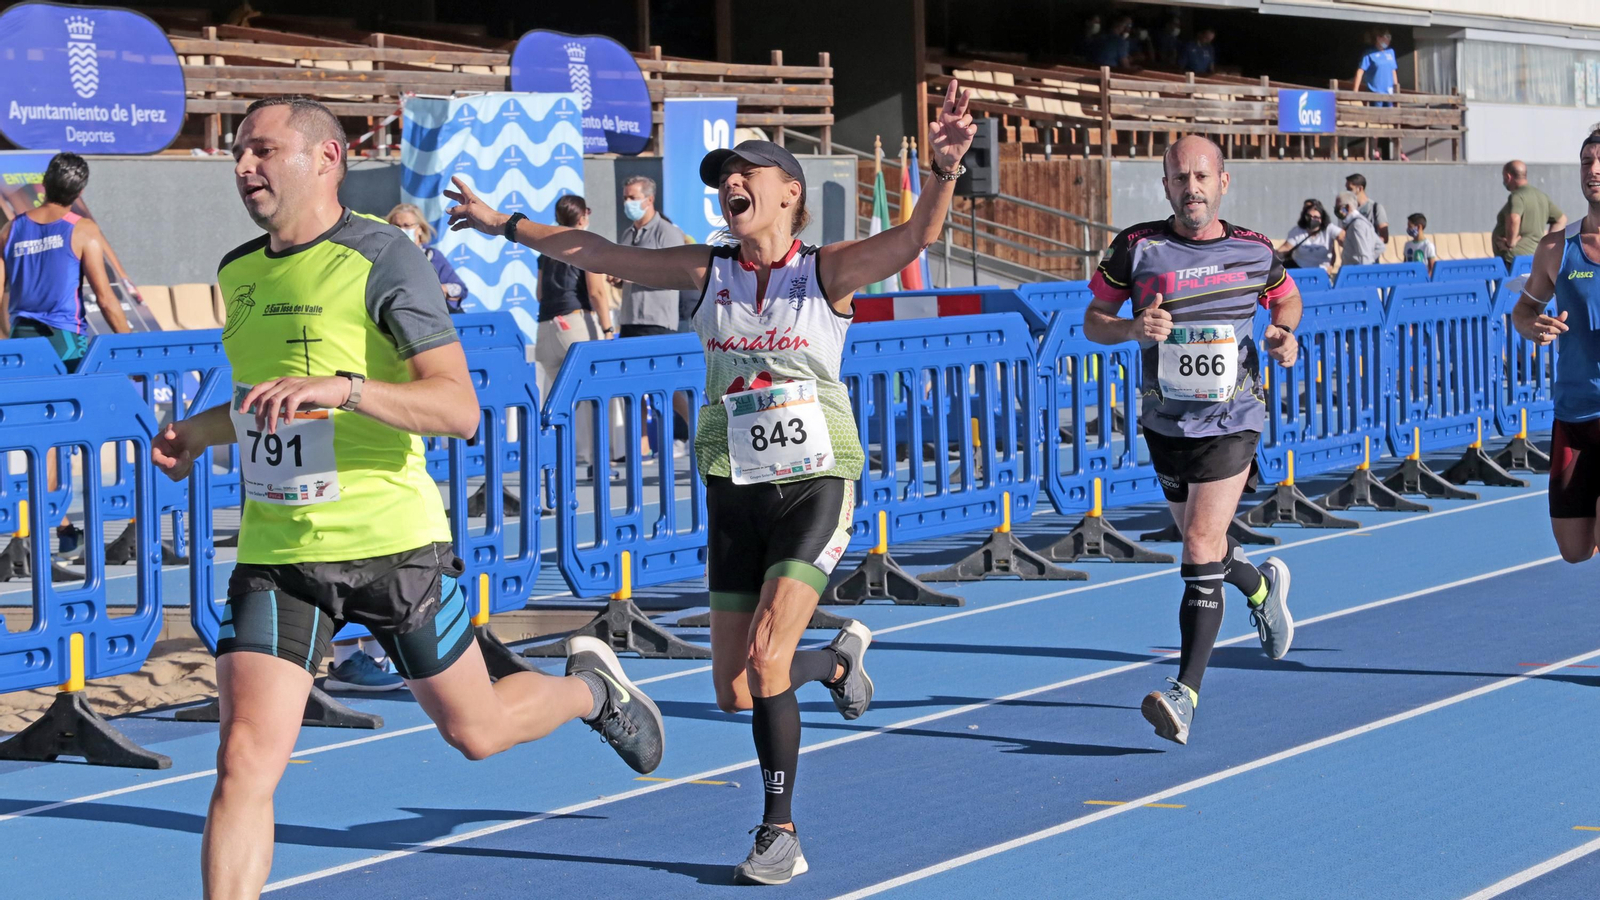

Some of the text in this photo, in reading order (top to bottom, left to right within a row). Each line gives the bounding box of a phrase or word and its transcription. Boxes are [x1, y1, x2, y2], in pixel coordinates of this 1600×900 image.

[9, 100, 167, 127] Ayuntamiento de Jerez
[602, 114, 615, 131] de
[614, 115, 641, 134] Jerez
[66, 126, 115, 147] Deportes
[1176, 265, 1225, 279] TRAIL
[1177, 271, 1247, 292] PILARES
[304, 304, 323, 314] Valle
[707, 326, 809, 352] maratón
[1179, 354, 1226, 377] 866
[750, 418, 807, 452] 843
[246, 430, 303, 467] 791
[1188, 599, 1218, 609] SPORTLAST
